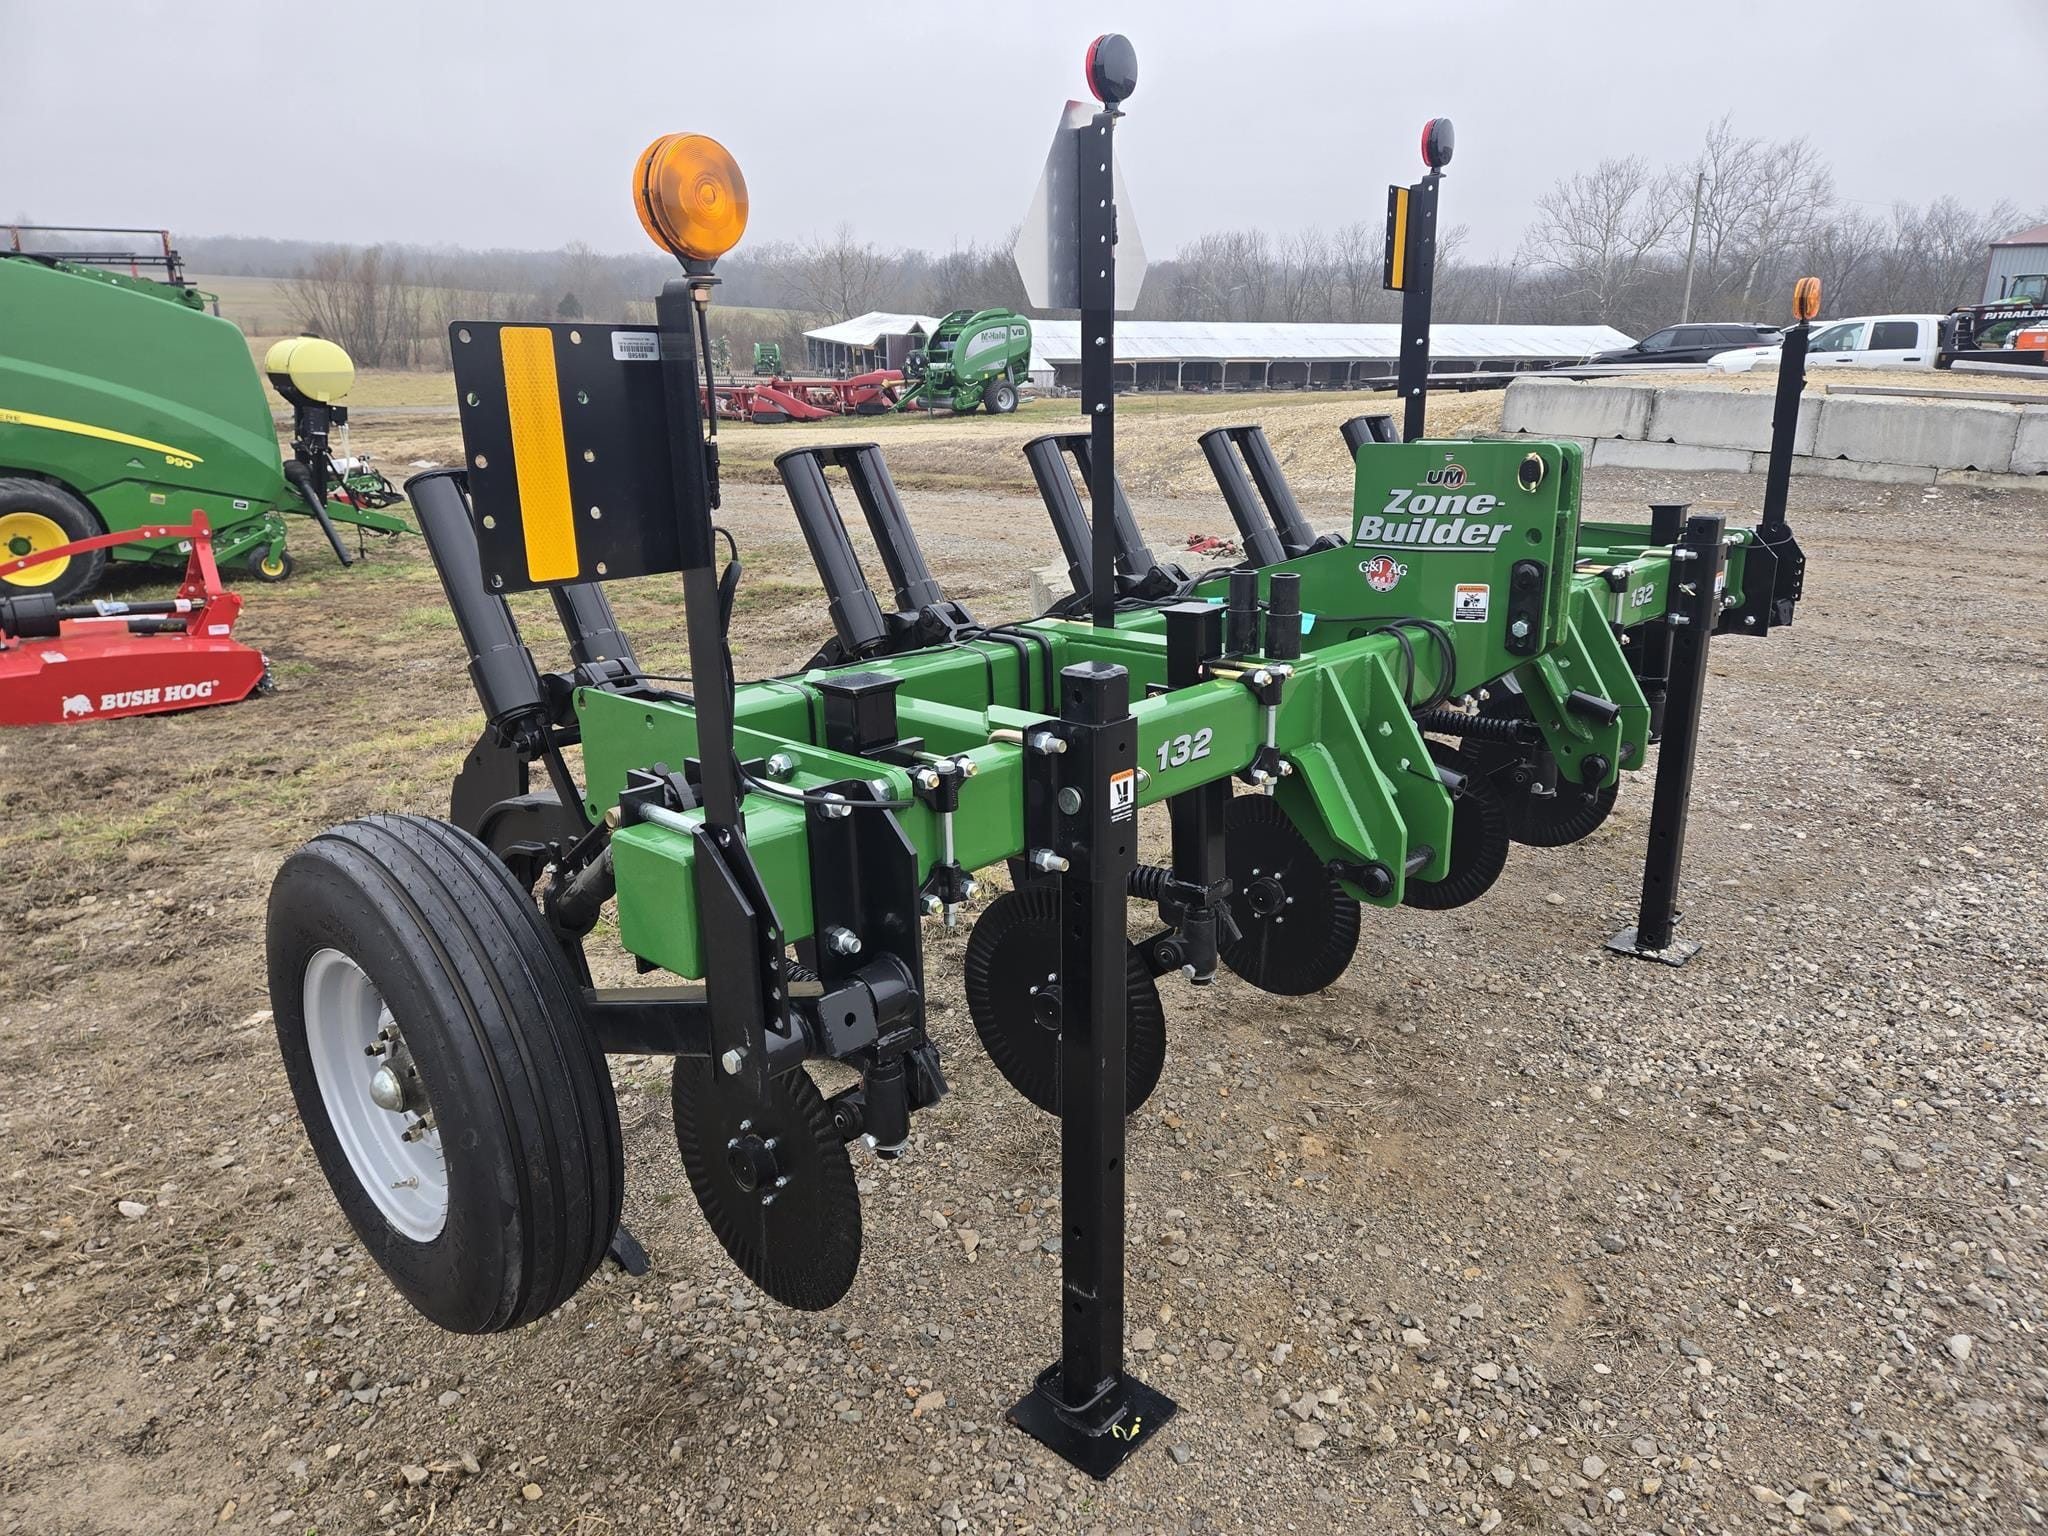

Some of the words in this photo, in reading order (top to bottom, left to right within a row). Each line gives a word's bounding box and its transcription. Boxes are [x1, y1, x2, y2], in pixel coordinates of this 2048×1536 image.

[165, 455, 194, 469] 990
[1427, 470, 1464, 485] UM
[1382, 488, 1506, 516] Zone-
[1356, 515, 1513, 545] Builder
[1358, 560, 1384, 574] G&J
[1390, 562, 1408, 576] AG
[1631, 583, 1655, 608] 132
[100, 688, 161, 711] BUSH
[163, 681, 213, 702] HOG
[1156, 727, 1213, 773] 132
